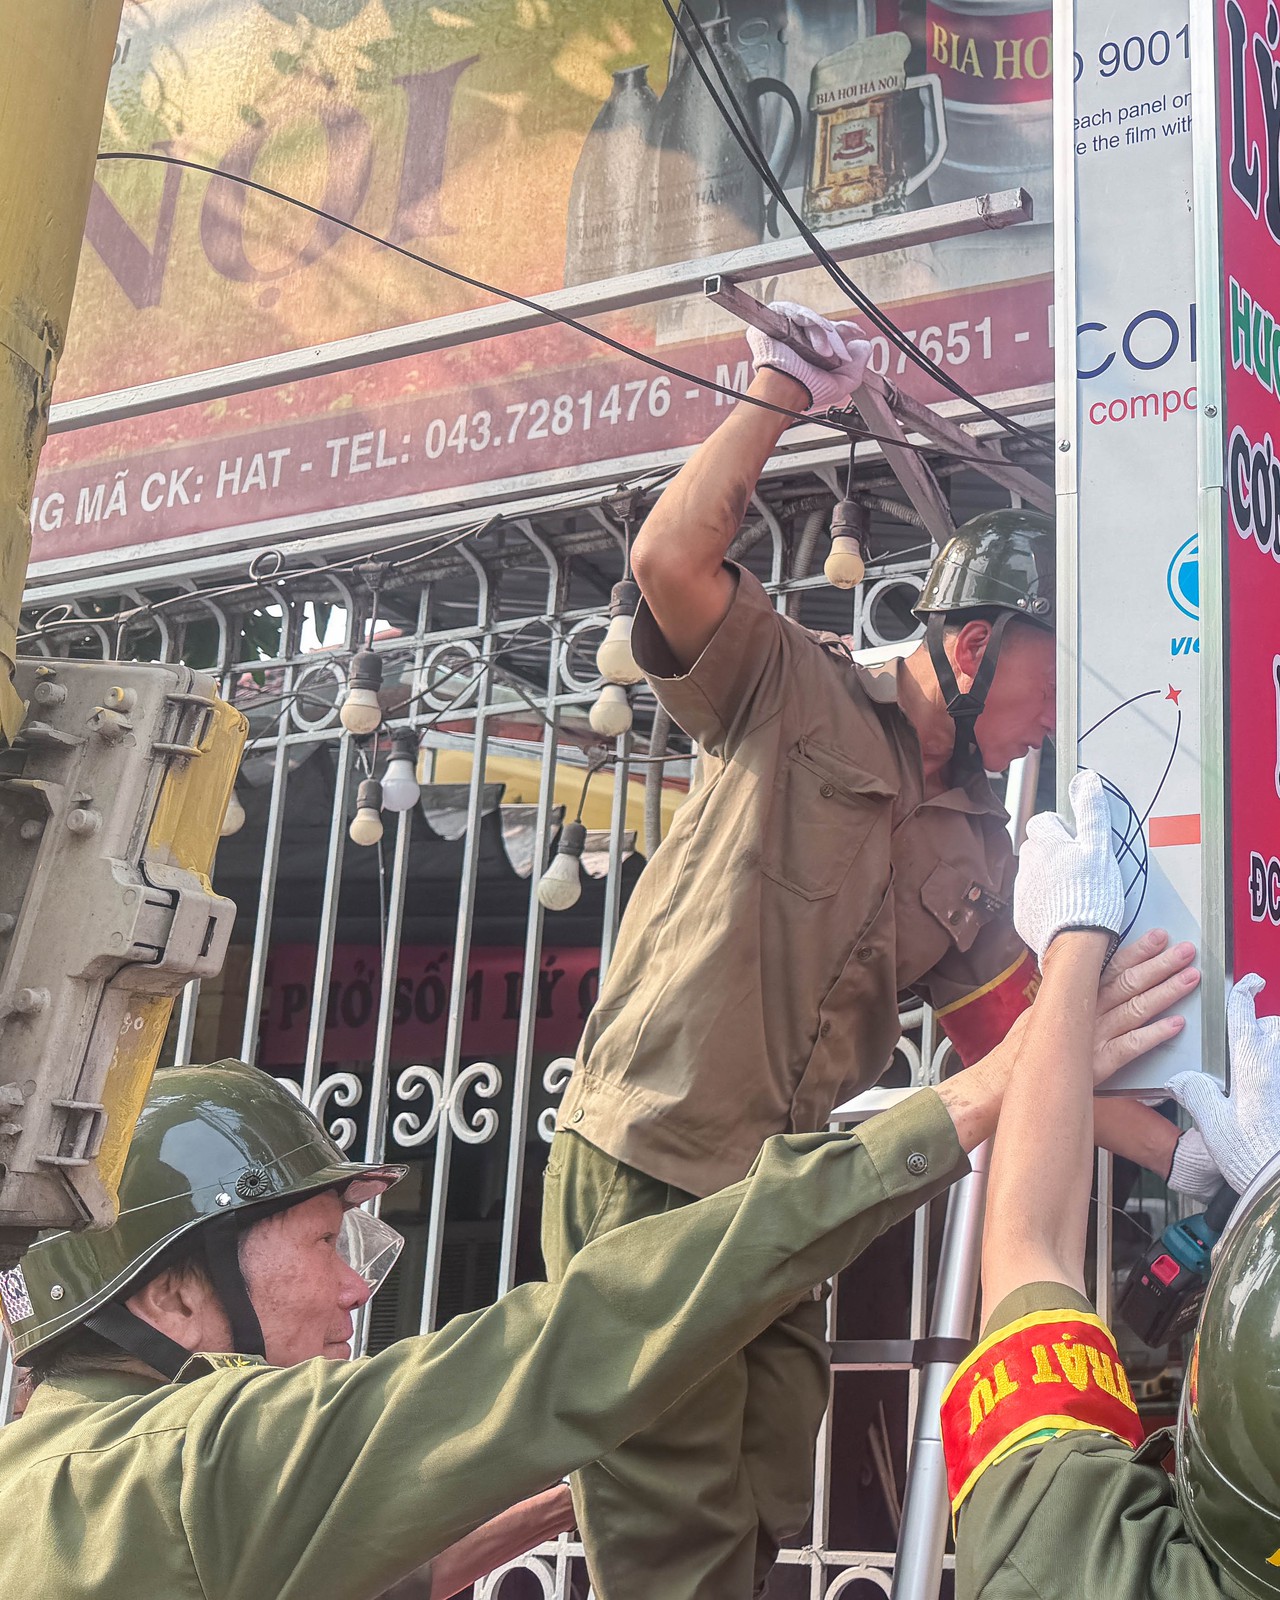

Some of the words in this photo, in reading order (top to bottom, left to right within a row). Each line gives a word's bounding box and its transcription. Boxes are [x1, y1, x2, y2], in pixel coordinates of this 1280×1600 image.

[932, 21, 984, 79] BIA
[1099, 24, 1189, 77] 9001
[816, 91, 836, 105] BIA
[1118, 95, 1166, 125] panel
[1092, 135, 1120, 152] the
[1125, 127, 1156, 145] film
[74, 468, 130, 526] MÃ
[140, 465, 205, 513] CK:
[216, 448, 291, 499] HAT
[325, 431, 411, 478] TEL:
[425, 375, 672, 460] 043.7281476
